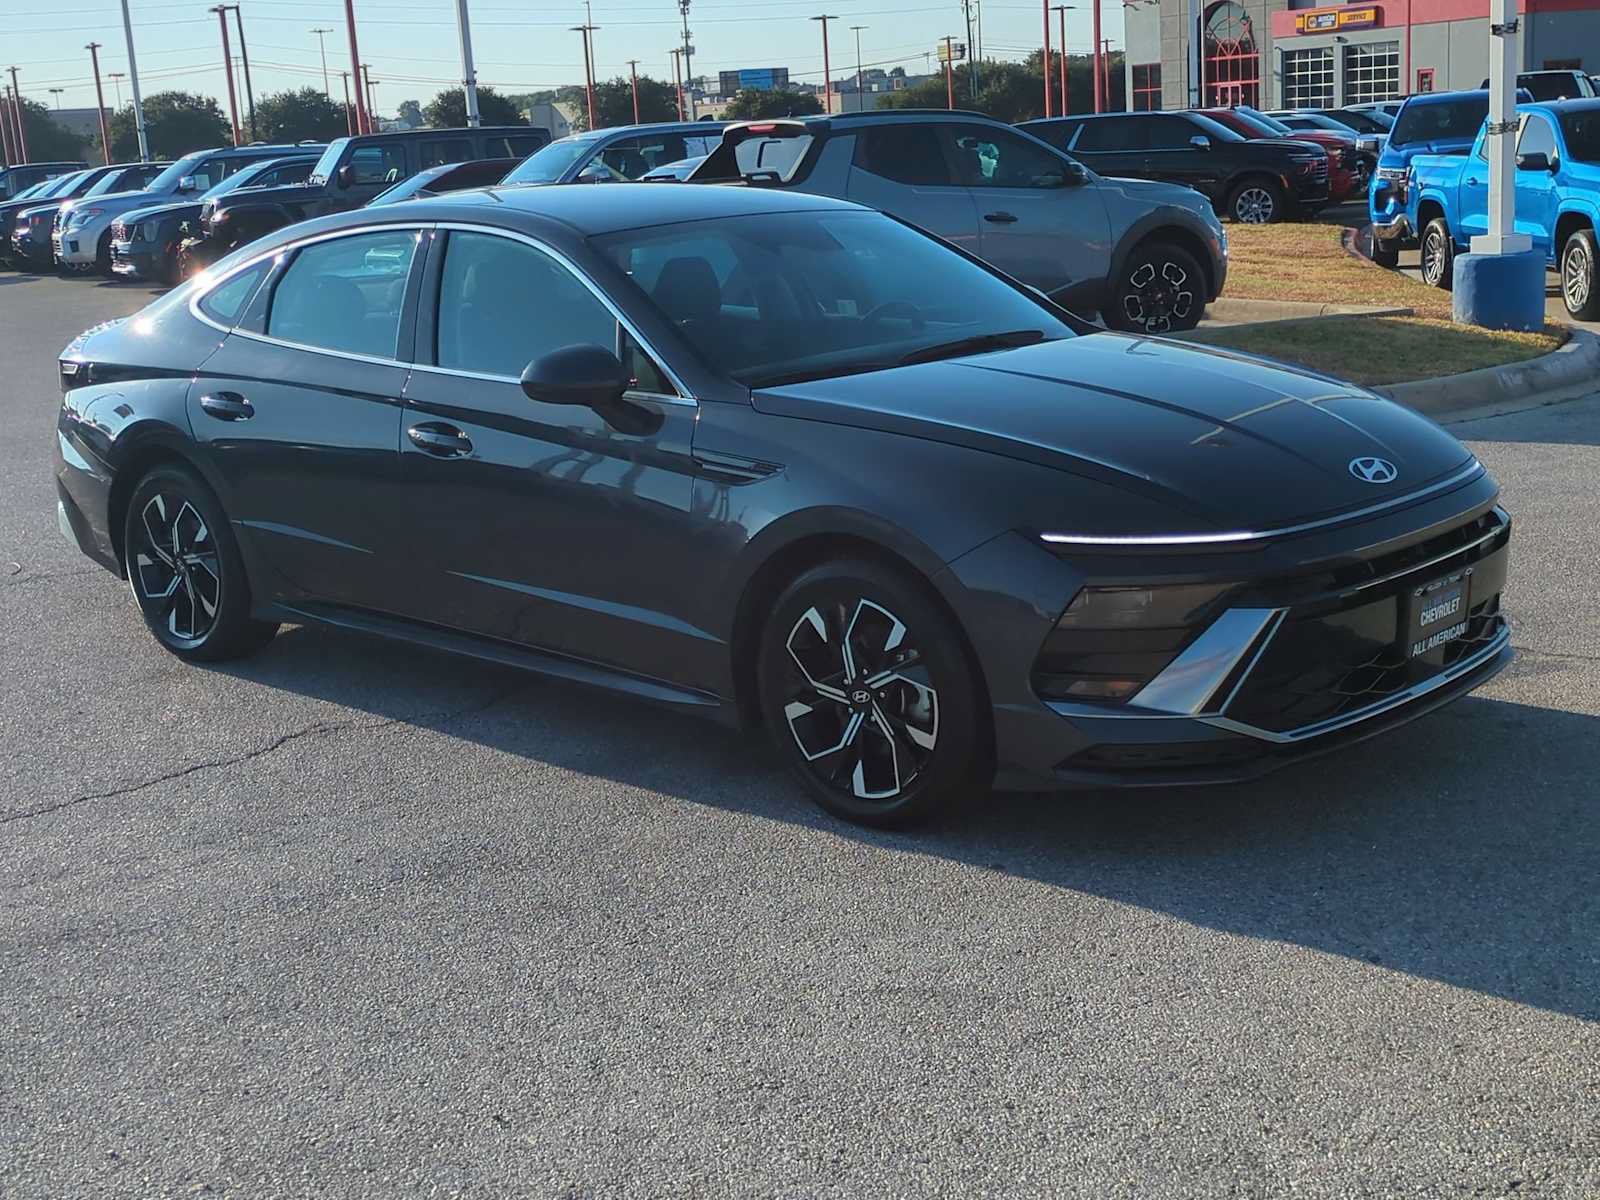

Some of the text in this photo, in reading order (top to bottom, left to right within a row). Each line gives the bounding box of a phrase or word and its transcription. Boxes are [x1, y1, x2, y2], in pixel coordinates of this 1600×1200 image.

[1421, 597, 1460, 626] CHEVROLET
[1412, 622, 1466, 656] ALL AMERICAN
